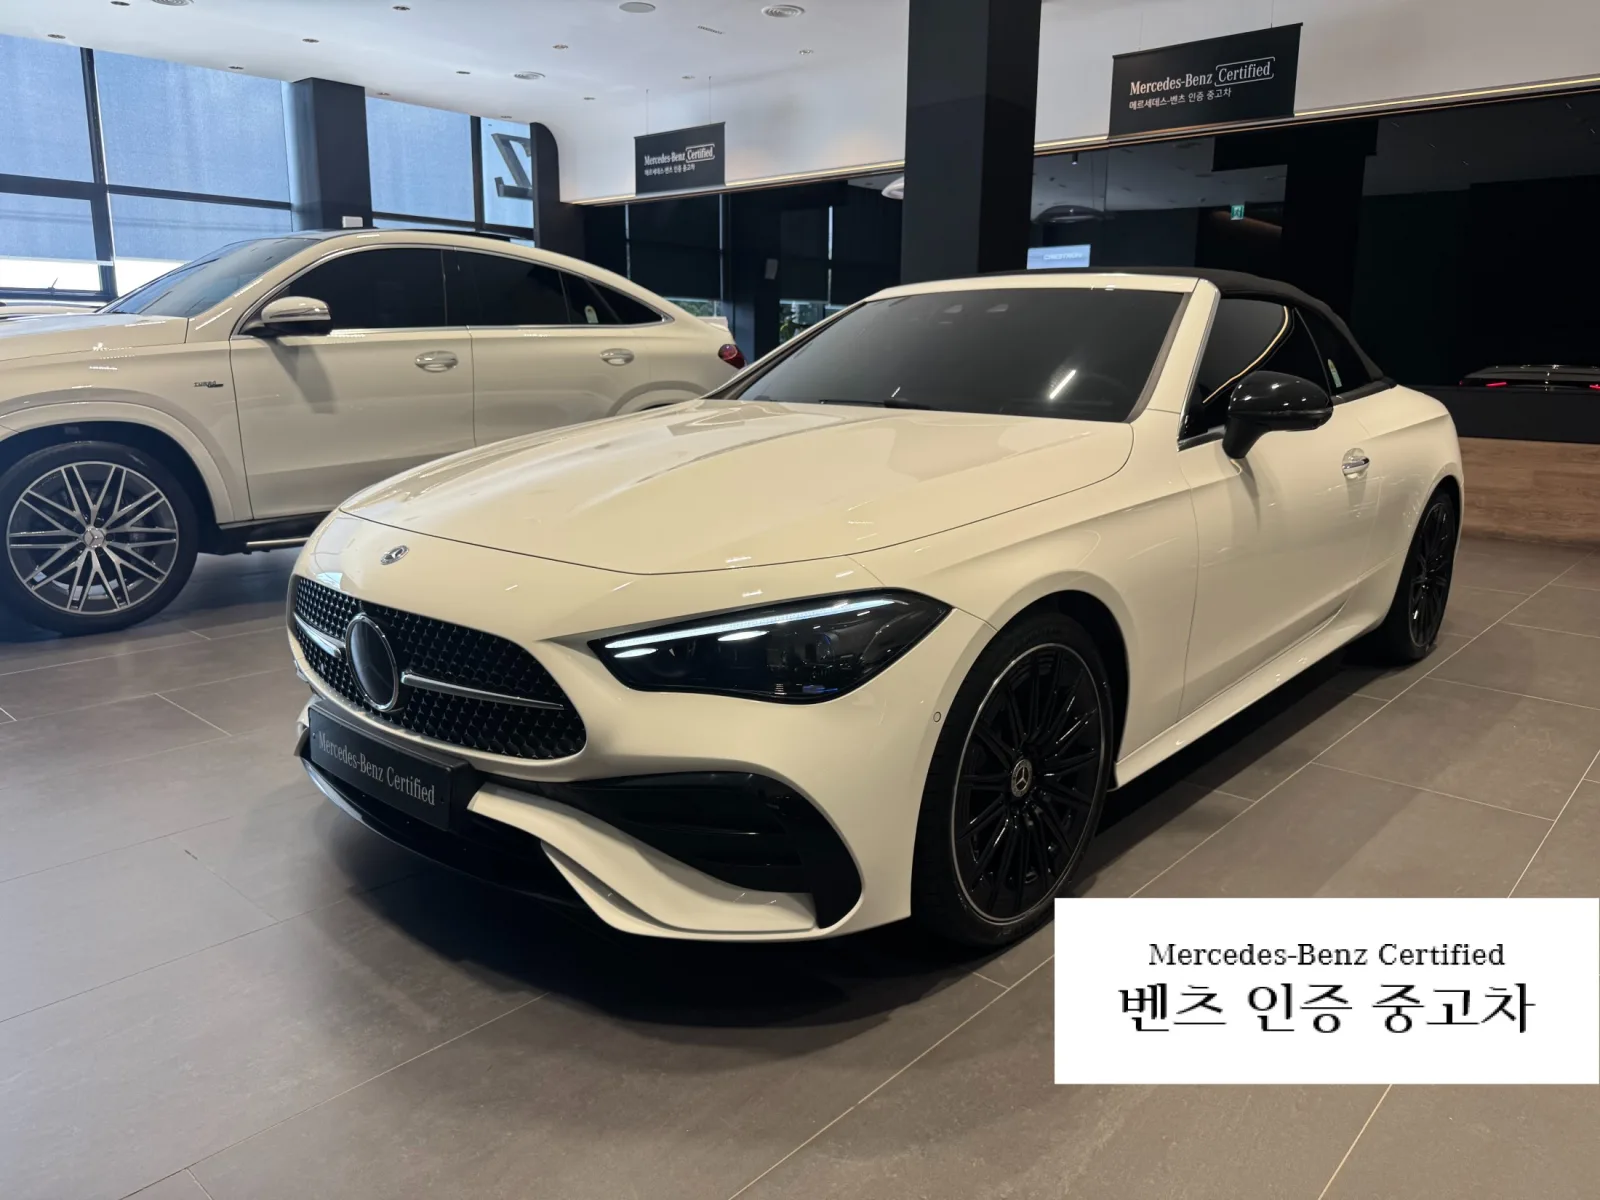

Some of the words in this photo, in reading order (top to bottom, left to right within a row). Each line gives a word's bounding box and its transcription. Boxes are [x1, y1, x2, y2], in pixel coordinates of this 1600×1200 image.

[1130, 73, 1213, 95] Mercedes-Benz
[1218, 62, 1270, 82] Certified
[1129, 95, 1186, 110] 메르세데스-벤츠
[1188, 92, 1204, 102] 인증
[1207, 88, 1231, 100] 중고차
[644, 151, 685, 165] Mercedes-Benz
[687, 147, 712, 159] Certified
[318, 731, 384, 783] Mercedes-Benz
[386, 766, 436, 806] Certified
